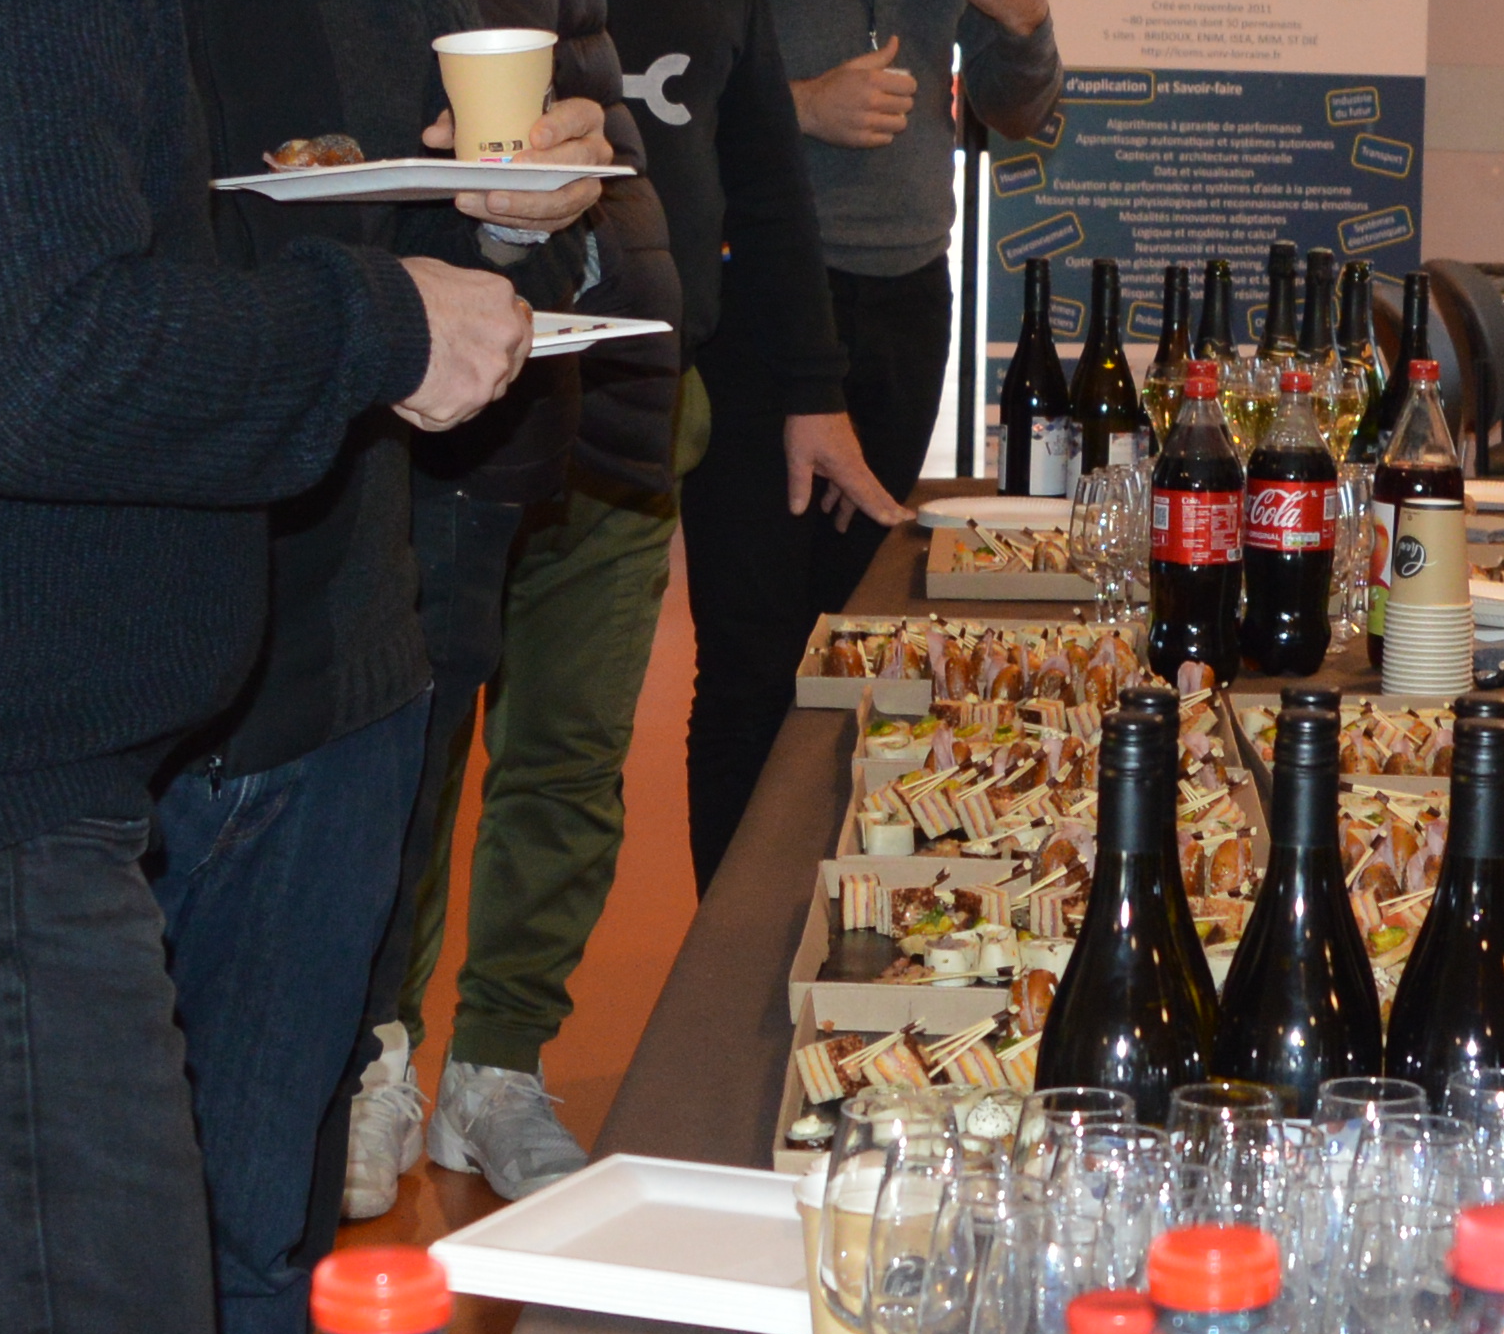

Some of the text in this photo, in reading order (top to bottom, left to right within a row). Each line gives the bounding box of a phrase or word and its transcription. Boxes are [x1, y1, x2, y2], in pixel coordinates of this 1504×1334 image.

[1193, 0, 1243, 13] novembre
[1144, 17, 1197, 29] personnes
[1200, 17, 1223, 28] dont
[1157, 83, 1169, 94] et
[1173, 81, 1243, 96] Savoir-faire
[1331, 93, 1372, 107] Industrie
[1349, 106, 1372, 118] futur
[1106, 118, 1169, 133] Algorithmes
[1179, 121, 1220, 134] garantie
[1222, 121, 1236, 133] de
[1237, 122, 1303, 136] performance
[1075, 133, 1335, 151] Apprentissage automatique et systèmes autonomes
[1114, 149, 1293, 164] Capteurs et architecture matérielle
[1361, 144, 1404, 165] Transport
[998, 166, 1038, 184] Humain
[1153, 167, 1255, 179] Data et visualisation
[1053, 178, 1107, 192] Évaluation
[1109, 180, 1122, 192] de
[1124, 180, 1190, 195] performance
[1192, 182, 1203, 193] et
[1205, 182, 1251, 196] systèmes
[1293, 184, 1303, 196] la
[1305, 186, 1352, 199] personne
[1034, 195, 1369, 212] Mesure de signaux physiologiques et reconnaissance des émotions
[1119, 211, 1287, 227] Modalités innovantes adaptatives
[1352, 214, 1396, 234] Systèmes
[1131, 227, 1277, 241] Logique et modèles de calcul
[1134, 242, 1271, 256] Neurotoxicité et bioactivité
